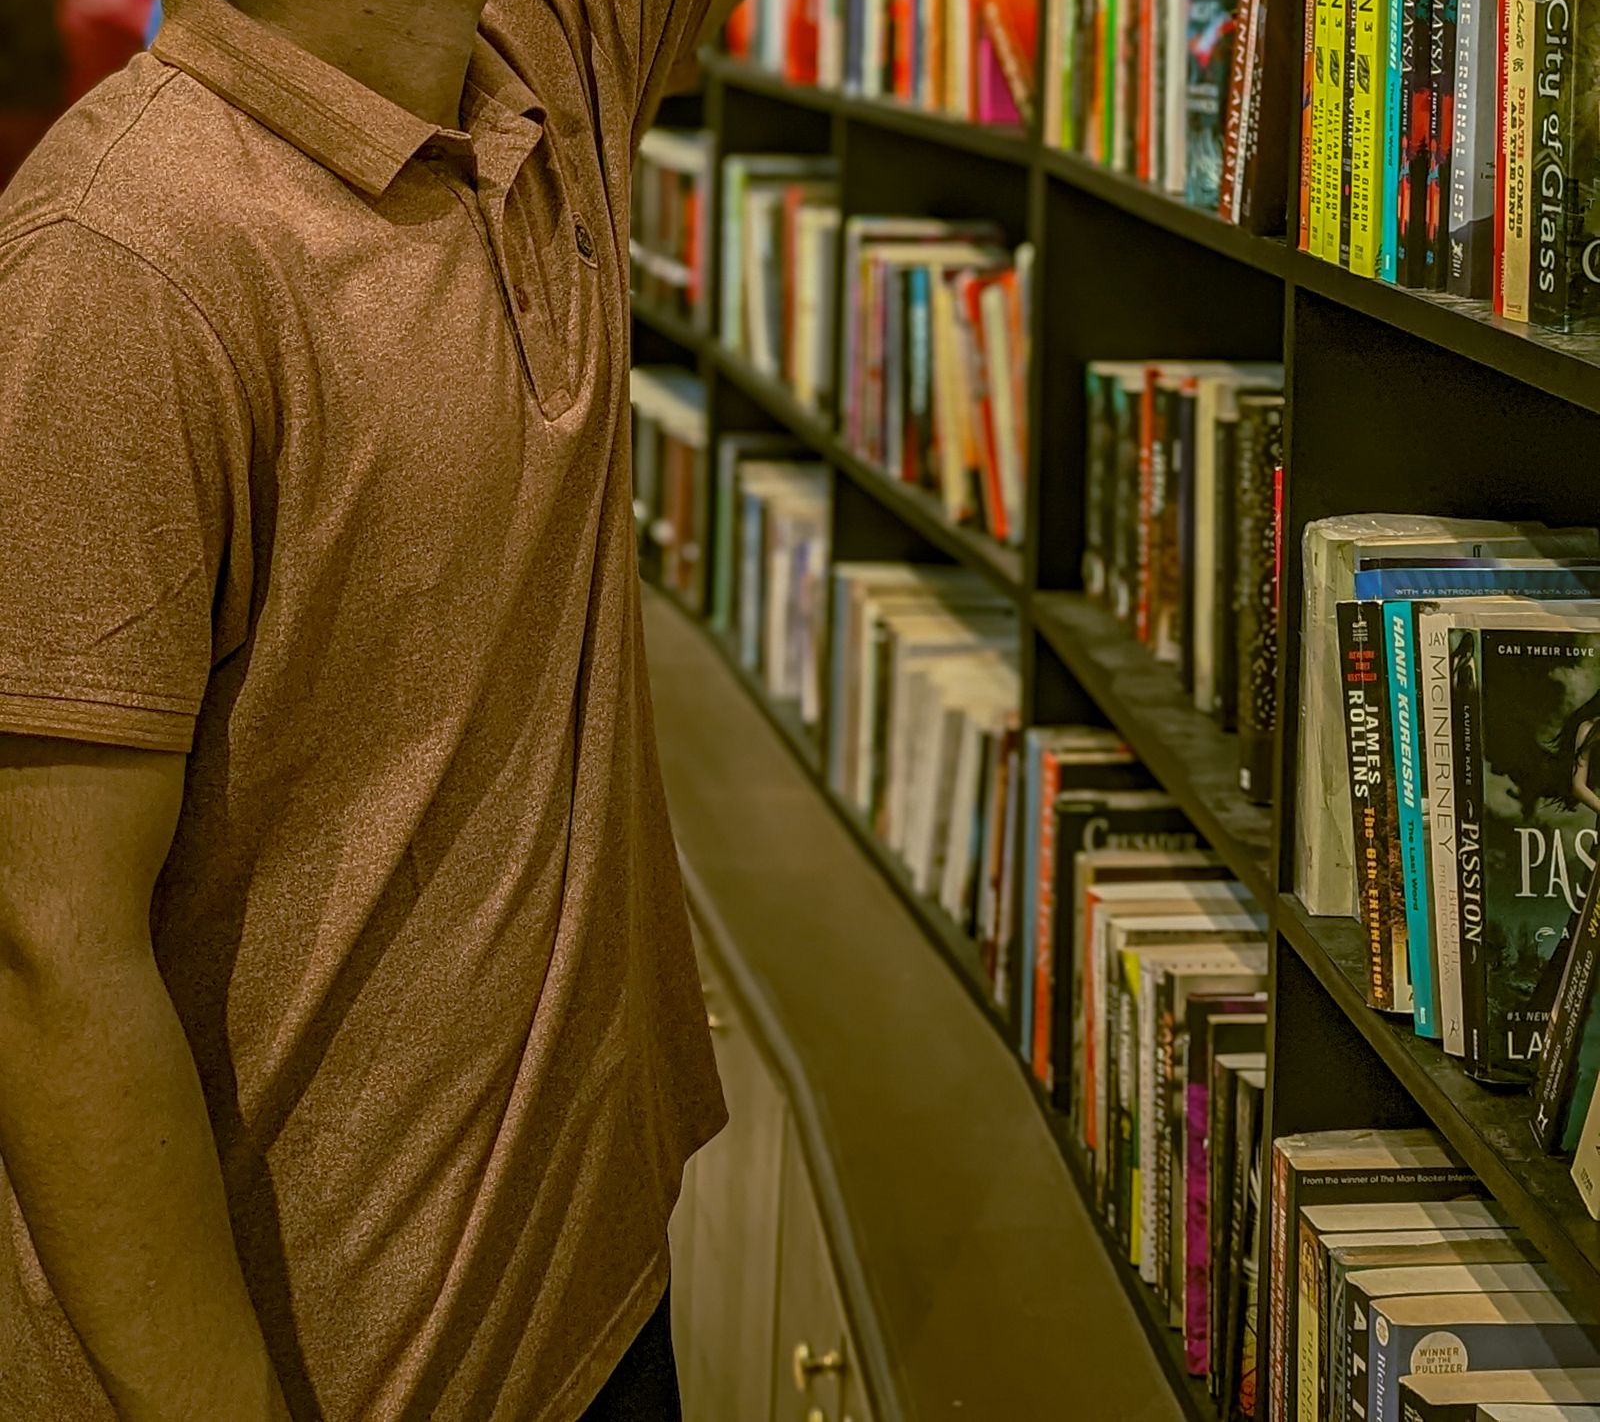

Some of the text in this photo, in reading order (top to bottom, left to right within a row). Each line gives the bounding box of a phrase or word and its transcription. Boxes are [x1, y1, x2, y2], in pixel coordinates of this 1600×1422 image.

[1503, 32, 1510, 48] OF
[1455, 36, 1470, 158] TERMINAL
[1510, 101, 1518, 130] AS
[1542, 113, 1563, 158] of
[1315, 98, 1325, 214] WILLIAM GIBSON
[1325, 143, 1333, 210] CADIGAN
[1331, 102, 1341, 221] WILLIAM GIBSON
[1352, 116, 1362, 222] PAT CADIGAN
[1361, 109, 1371, 233] WILLIAM GIBSON
[1453, 169, 1466, 222] LIST
[1516, 86, 1526, 239] DEATH COMES
[1539, 164, 1564, 293] Glass
[1394, 588, 1419, 596] WITH
[1422, 588, 1435, 596] AN
[1438, 588, 1505, 596] INTRODUCTION
[1429, 632, 1447, 647] JAY
[1497, 644, 1595, 657] CAN THEIR LOVE
[1348, 689, 1369, 798] ROLLINS
[1365, 703, 1381, 785] JAMES
[1393, 615, 1415, 809] HANIF KUREISHI
[1463, 705, 1472, 752] LAUREN
[1430, 654, 1454, 855] McINERNEY
[1364, 806, 1383, 999] The 6th EXTINCTION
[1407, 820, 1419, 912] The Last Word
[1438, 864, 1450, 950] PRECIOUS
[1458, 819, 1483, 945] PASSION
[1506, 1011, 1551, 1022] #1 NEW
[1302, 1174, 1446, 1185] From the winner of The Man Booker
[1415, 1363, 1463, 1374] PULITZER
[1418, 1347, 1459, 1357] WINNER
